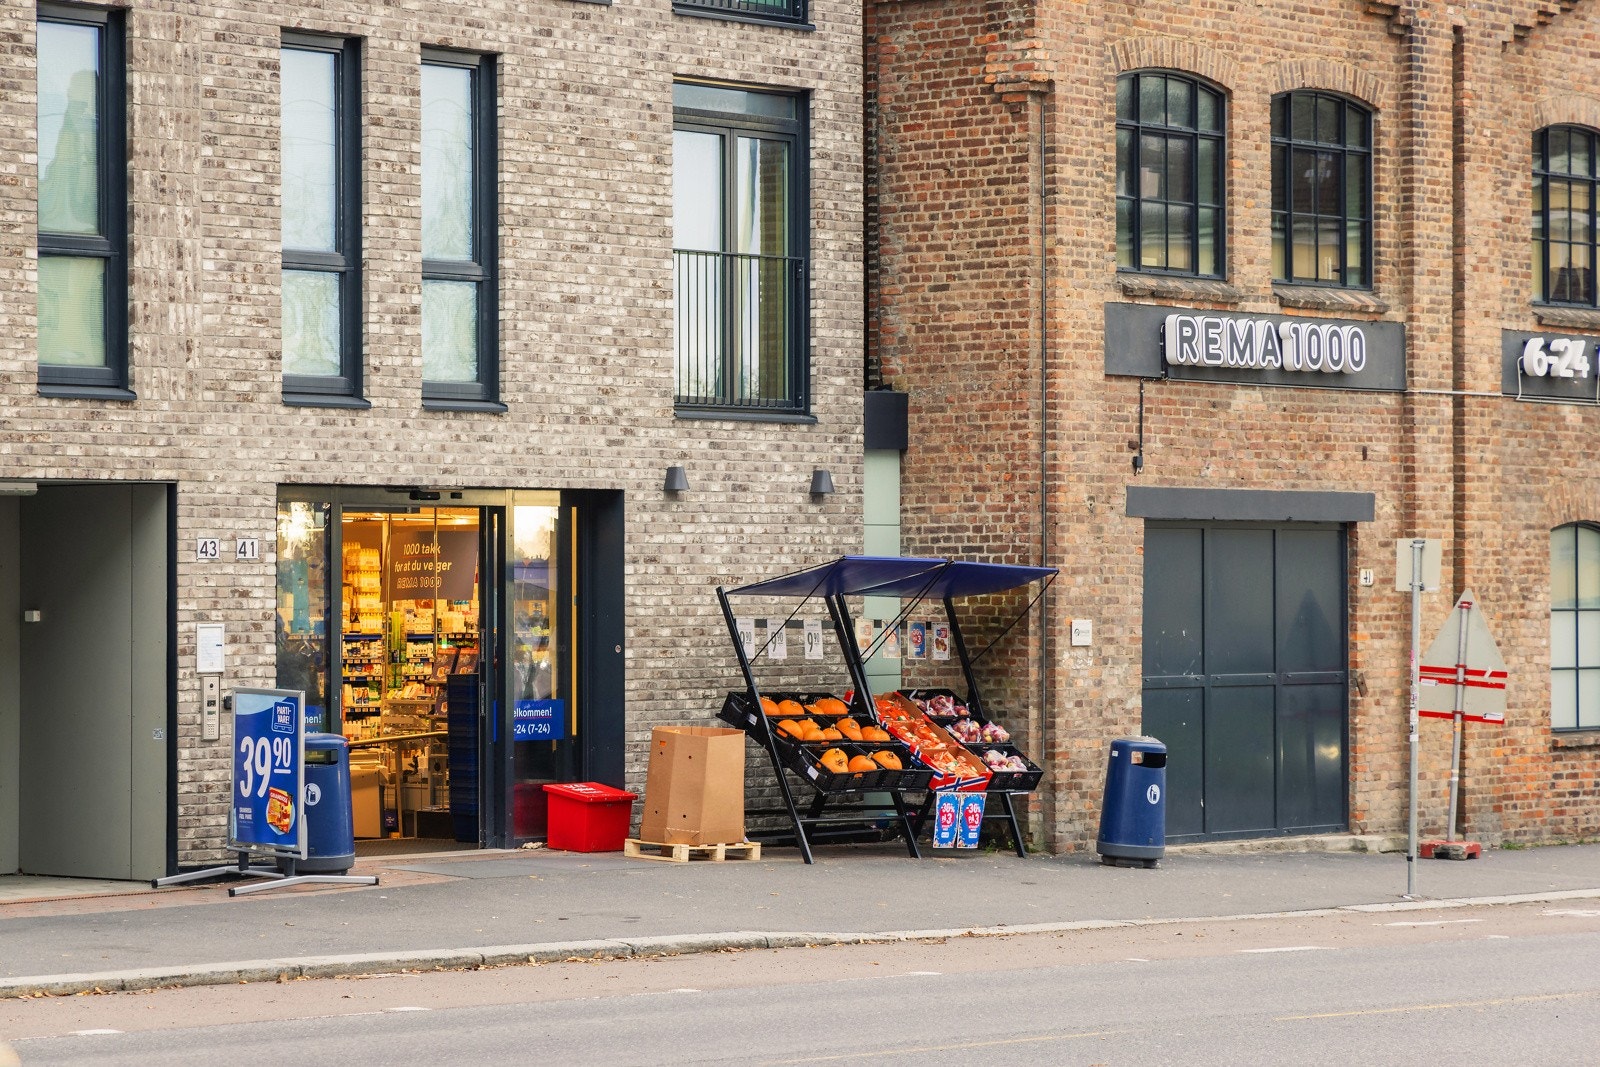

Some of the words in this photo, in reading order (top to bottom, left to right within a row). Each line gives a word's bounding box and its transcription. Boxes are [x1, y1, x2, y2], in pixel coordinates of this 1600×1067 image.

[1166, 314, 1282, 369] REMA
[1280, 321, 1366, 374] 1000
[1523, 337, 1590, 379] 6-24
[200, 540, 217, 557] 43
[238, 541, 255, 557] 41
[403, 543, 420, 555] 1000
[421, 542, 441, 554] takk
[394, 561, 404, 573] for
[403, 561, 411, 572] at
[411, 560, 422, 571] du
[423, 561, 452, 572] veger
[770, 631, 777, 653] 9
[807, 632, 814, 653] 9
[276, 706, 291, 715] PARTI-
[514, 707, 552, 717] elkommen!
[514, 725, 526, 734] -24
[527, 723, 551, 735] (7-24)
[240, 735, 272, 798] 39
[273, 737, 291, 767] 90
